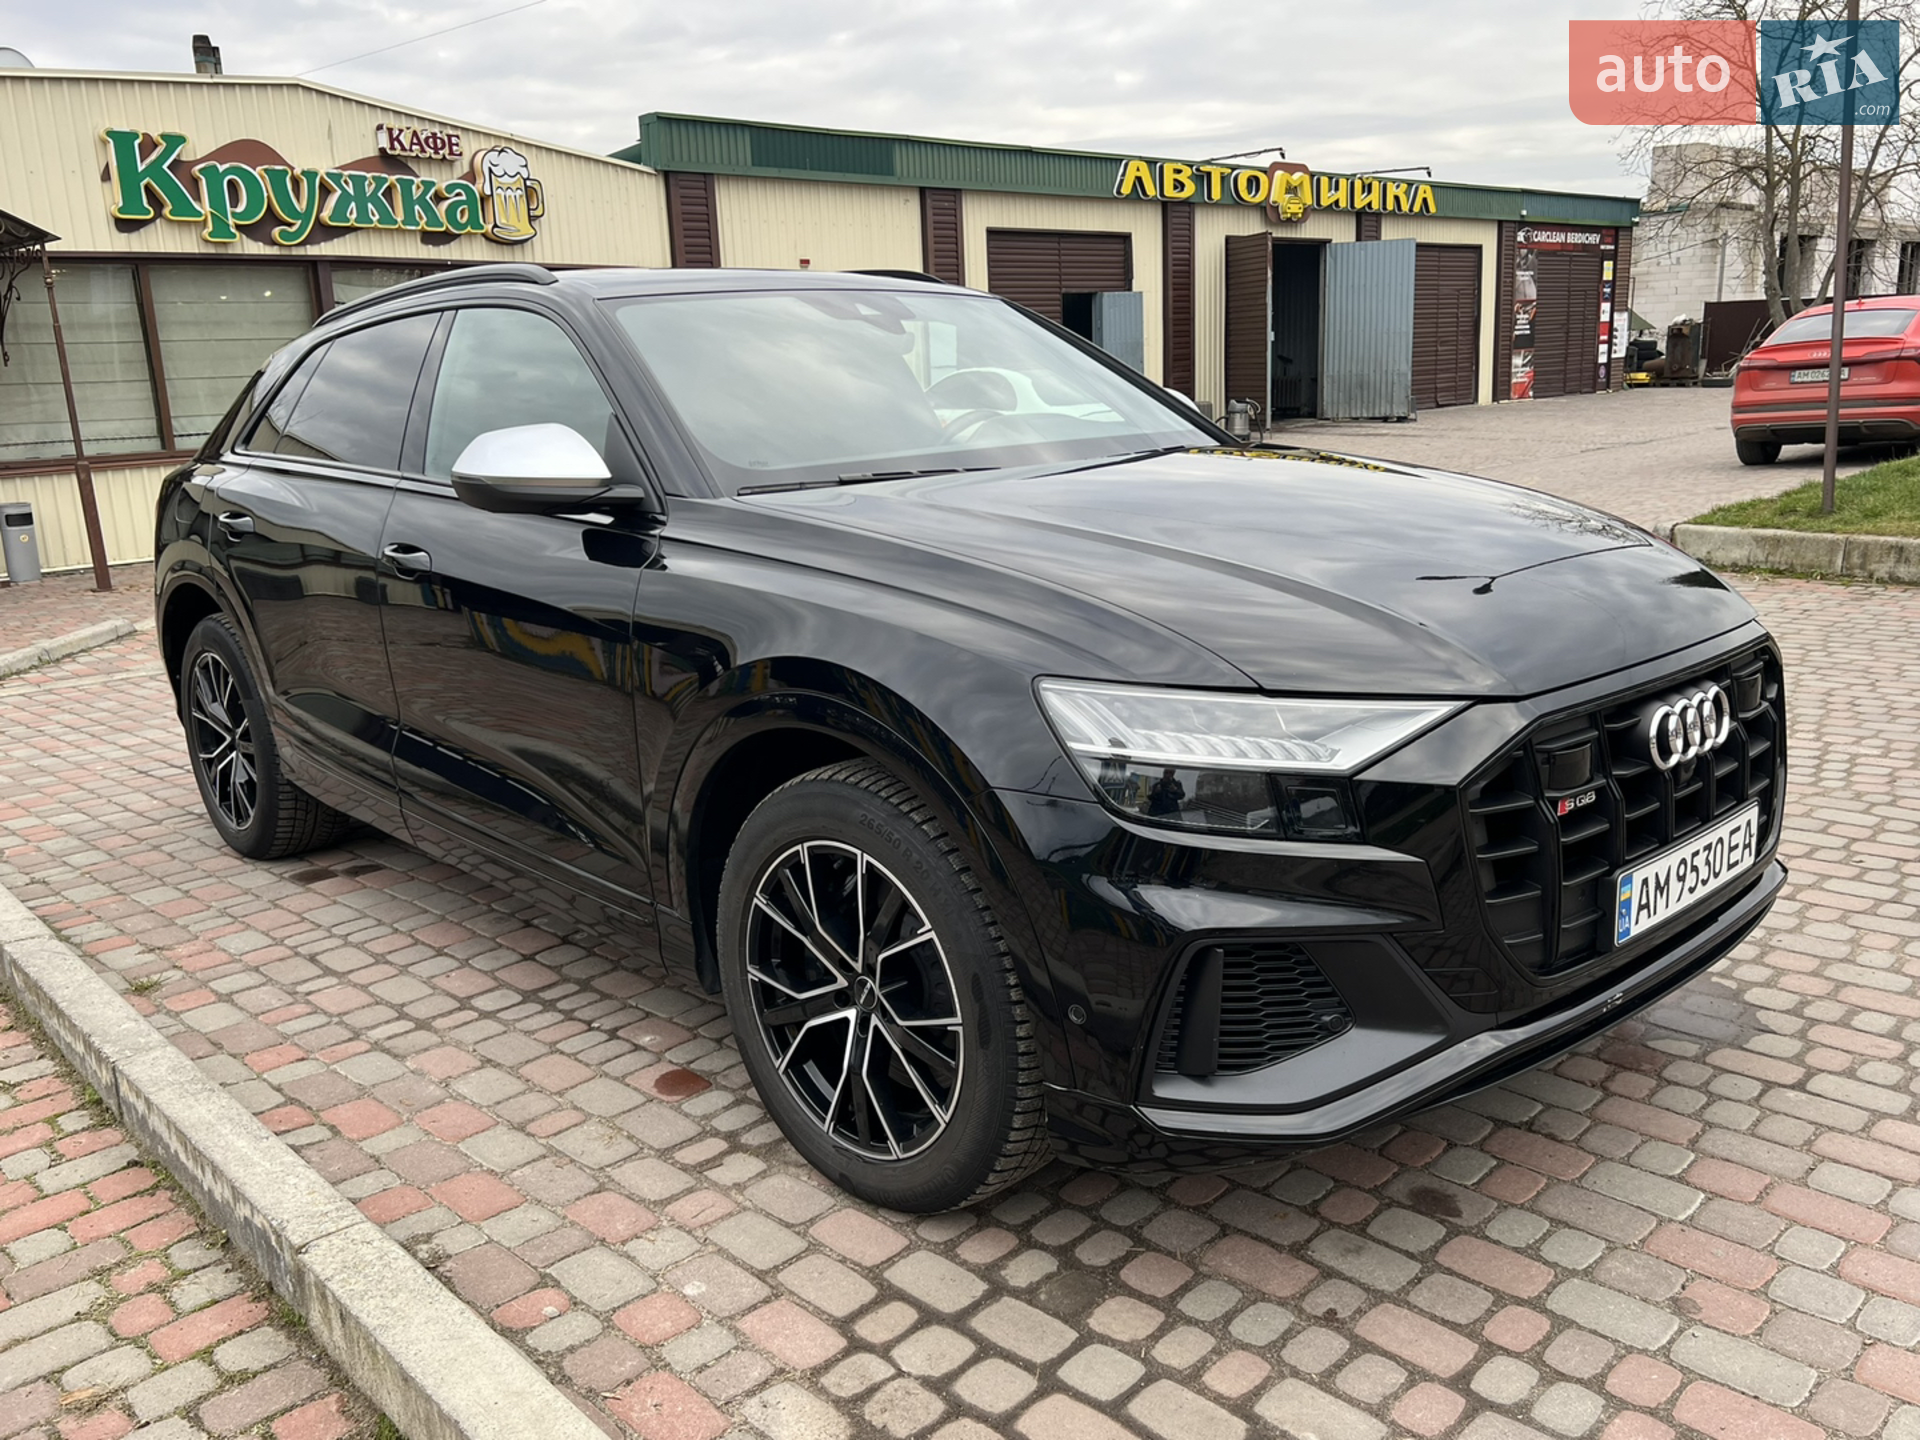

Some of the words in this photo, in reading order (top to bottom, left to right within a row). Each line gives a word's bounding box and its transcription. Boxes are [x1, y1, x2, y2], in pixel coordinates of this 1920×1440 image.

[384, 125, 463, 159] КАФЕ
[103, 128, 486, 245] Кружка
[1532, 230, 1566, 243] CARCLEAN
[859, 813, 902, 850] 265/50
